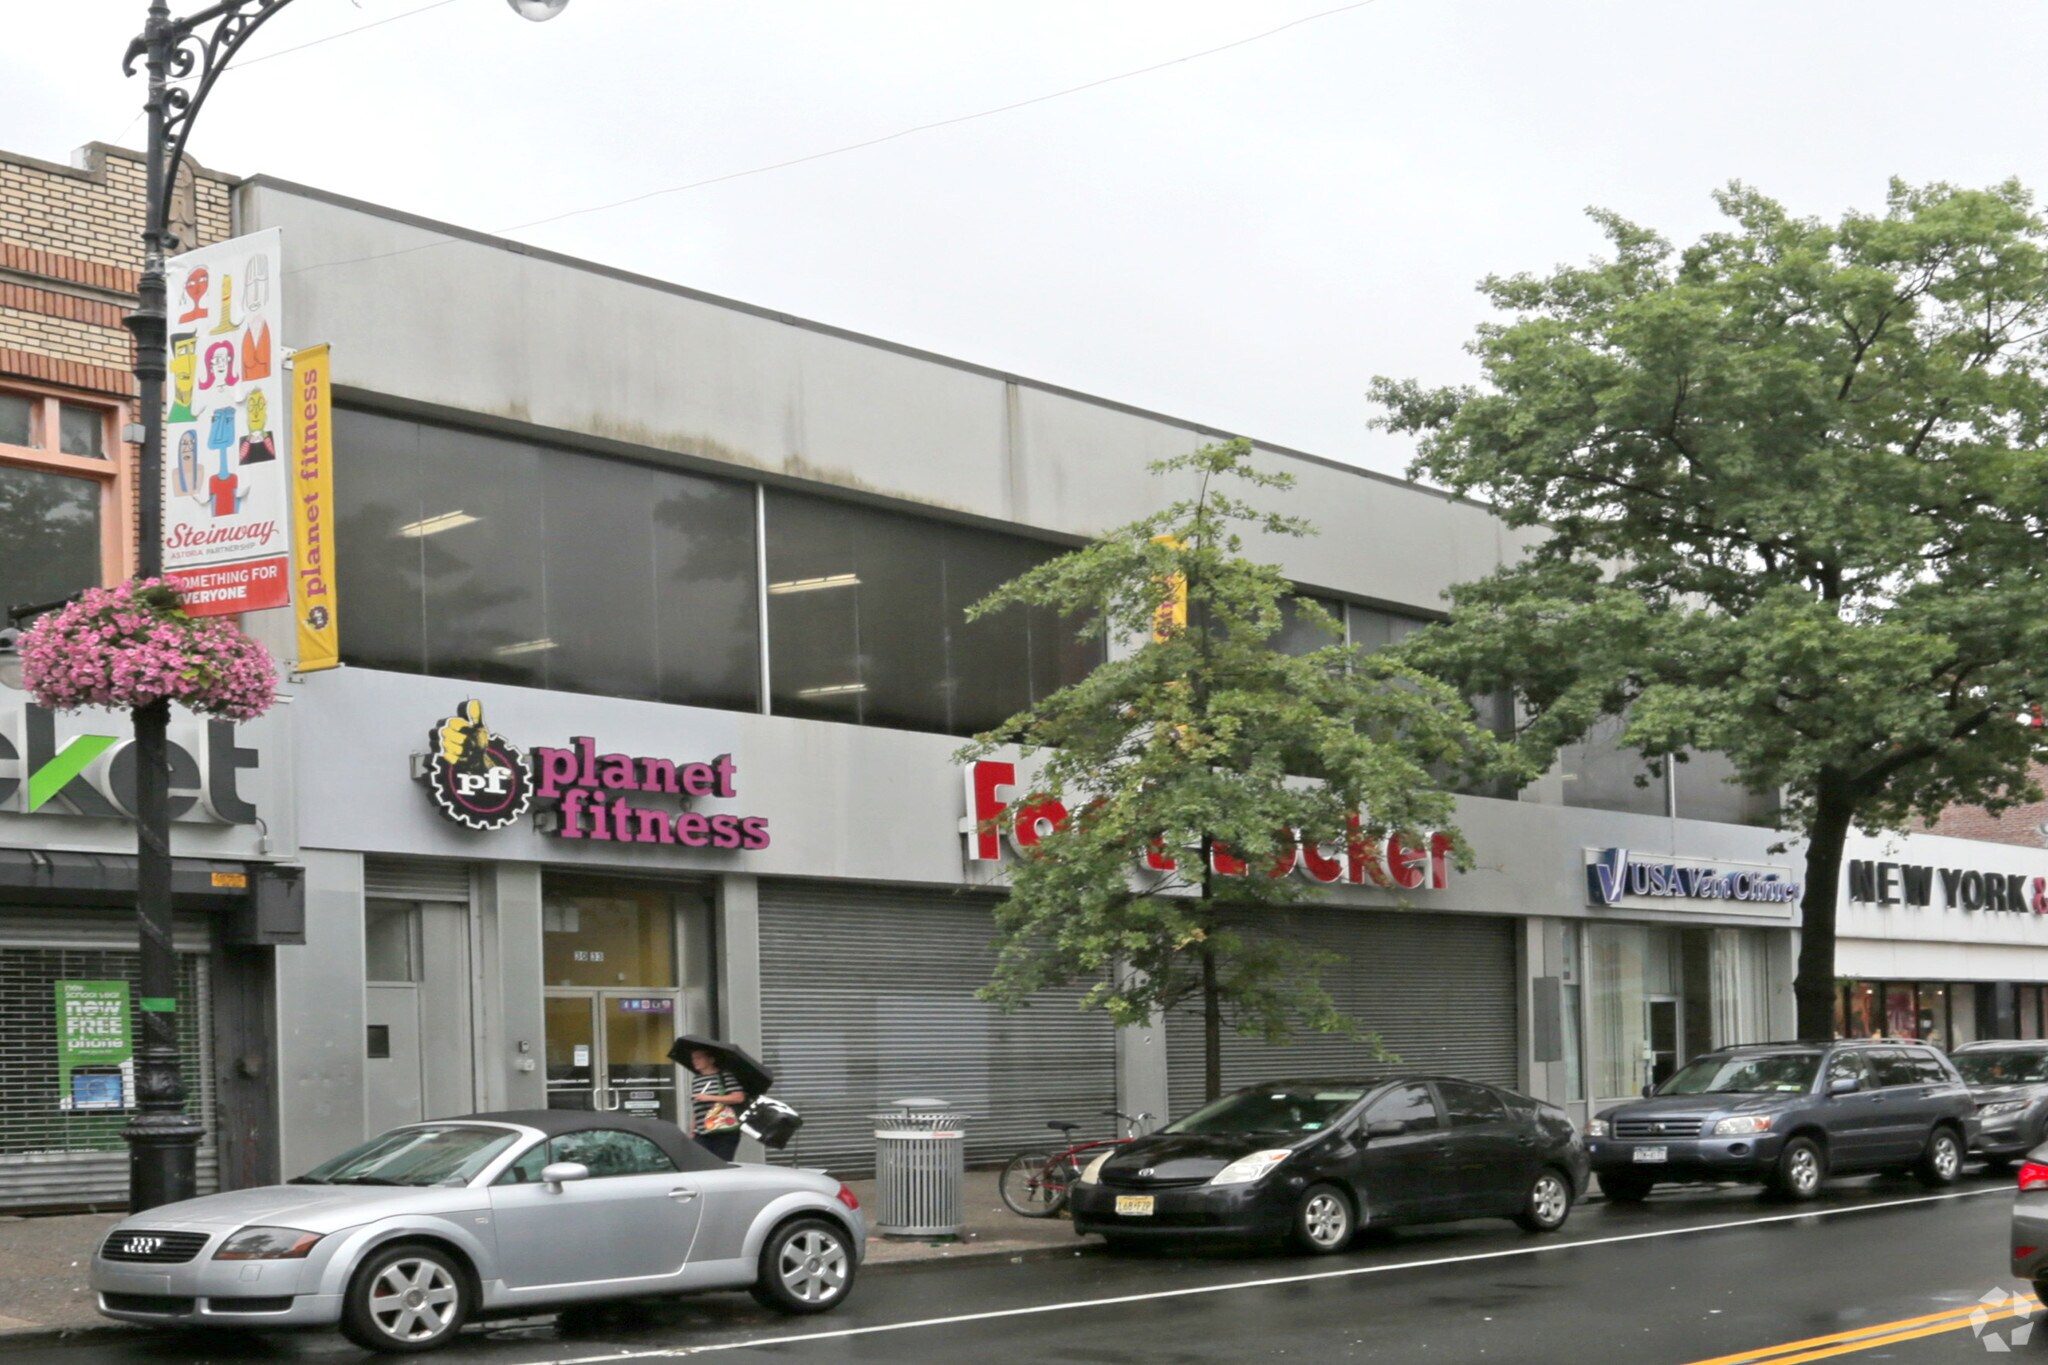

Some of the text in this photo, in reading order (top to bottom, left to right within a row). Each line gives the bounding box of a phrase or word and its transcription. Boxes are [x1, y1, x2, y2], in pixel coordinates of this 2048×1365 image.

[300, 367, 326, 598] planet fitness
[166, 520, 279, 549] Steinway
[171, 542, 255, 560] ASTORIA PARTNERSHIP
[179, 565, 278, 590] OMETHING FOR
[178, 586, 247, 604] VERYONE
[457, 766, 512, 796] pf
[534, 735, 737, 799] planet
[559, 789, 771, 850] fitness
[1630, 861, 1686, 898] USA
[1683, 867, 1732, 900] Vein
[1849, 859, 1934, 908] NEW
[1937, 867, 2029, 914] YORK
[65, 1000, 122, 1016] new
[67, 1017, 123, 1035] FREE
[67, 1036, 124, 1052] phone
